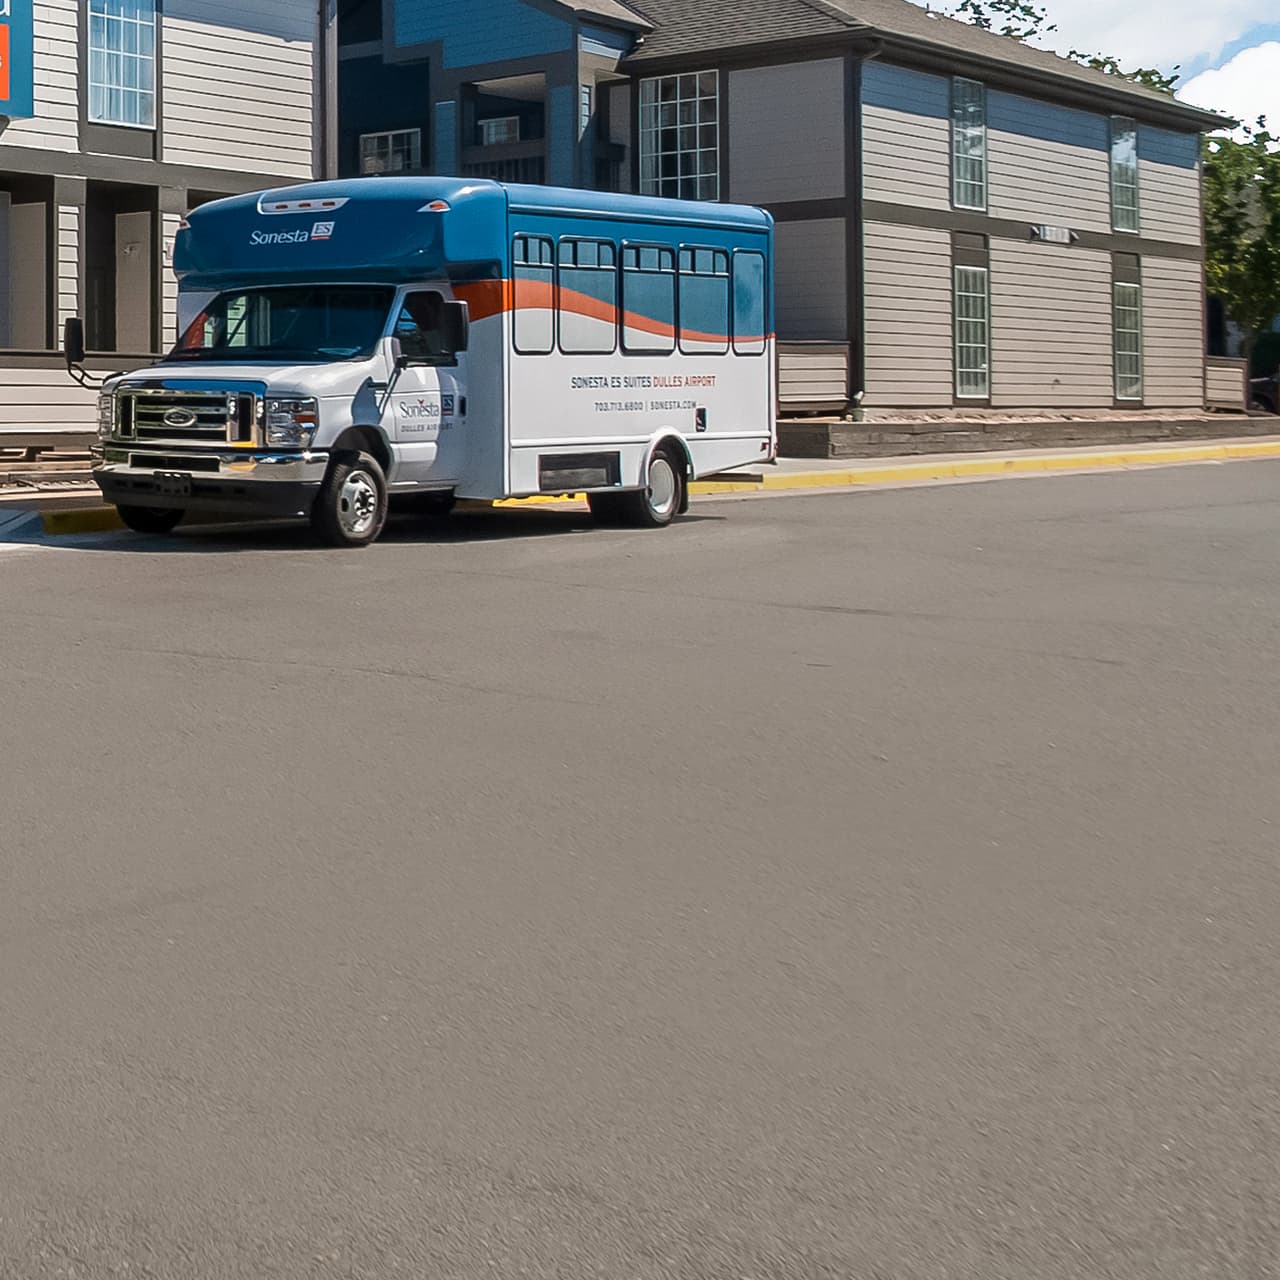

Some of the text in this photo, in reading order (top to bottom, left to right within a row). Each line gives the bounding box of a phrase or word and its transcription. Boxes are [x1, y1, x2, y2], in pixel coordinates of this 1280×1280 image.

[249, 229, 309, 246] Sonesta
[571, 375, 716, 389] SONESTA ES SUITES DULLES AIRPORT
[399, 401, 439, 418] Sonesta
[650, 400, 696, 410] SONESTA.COM
